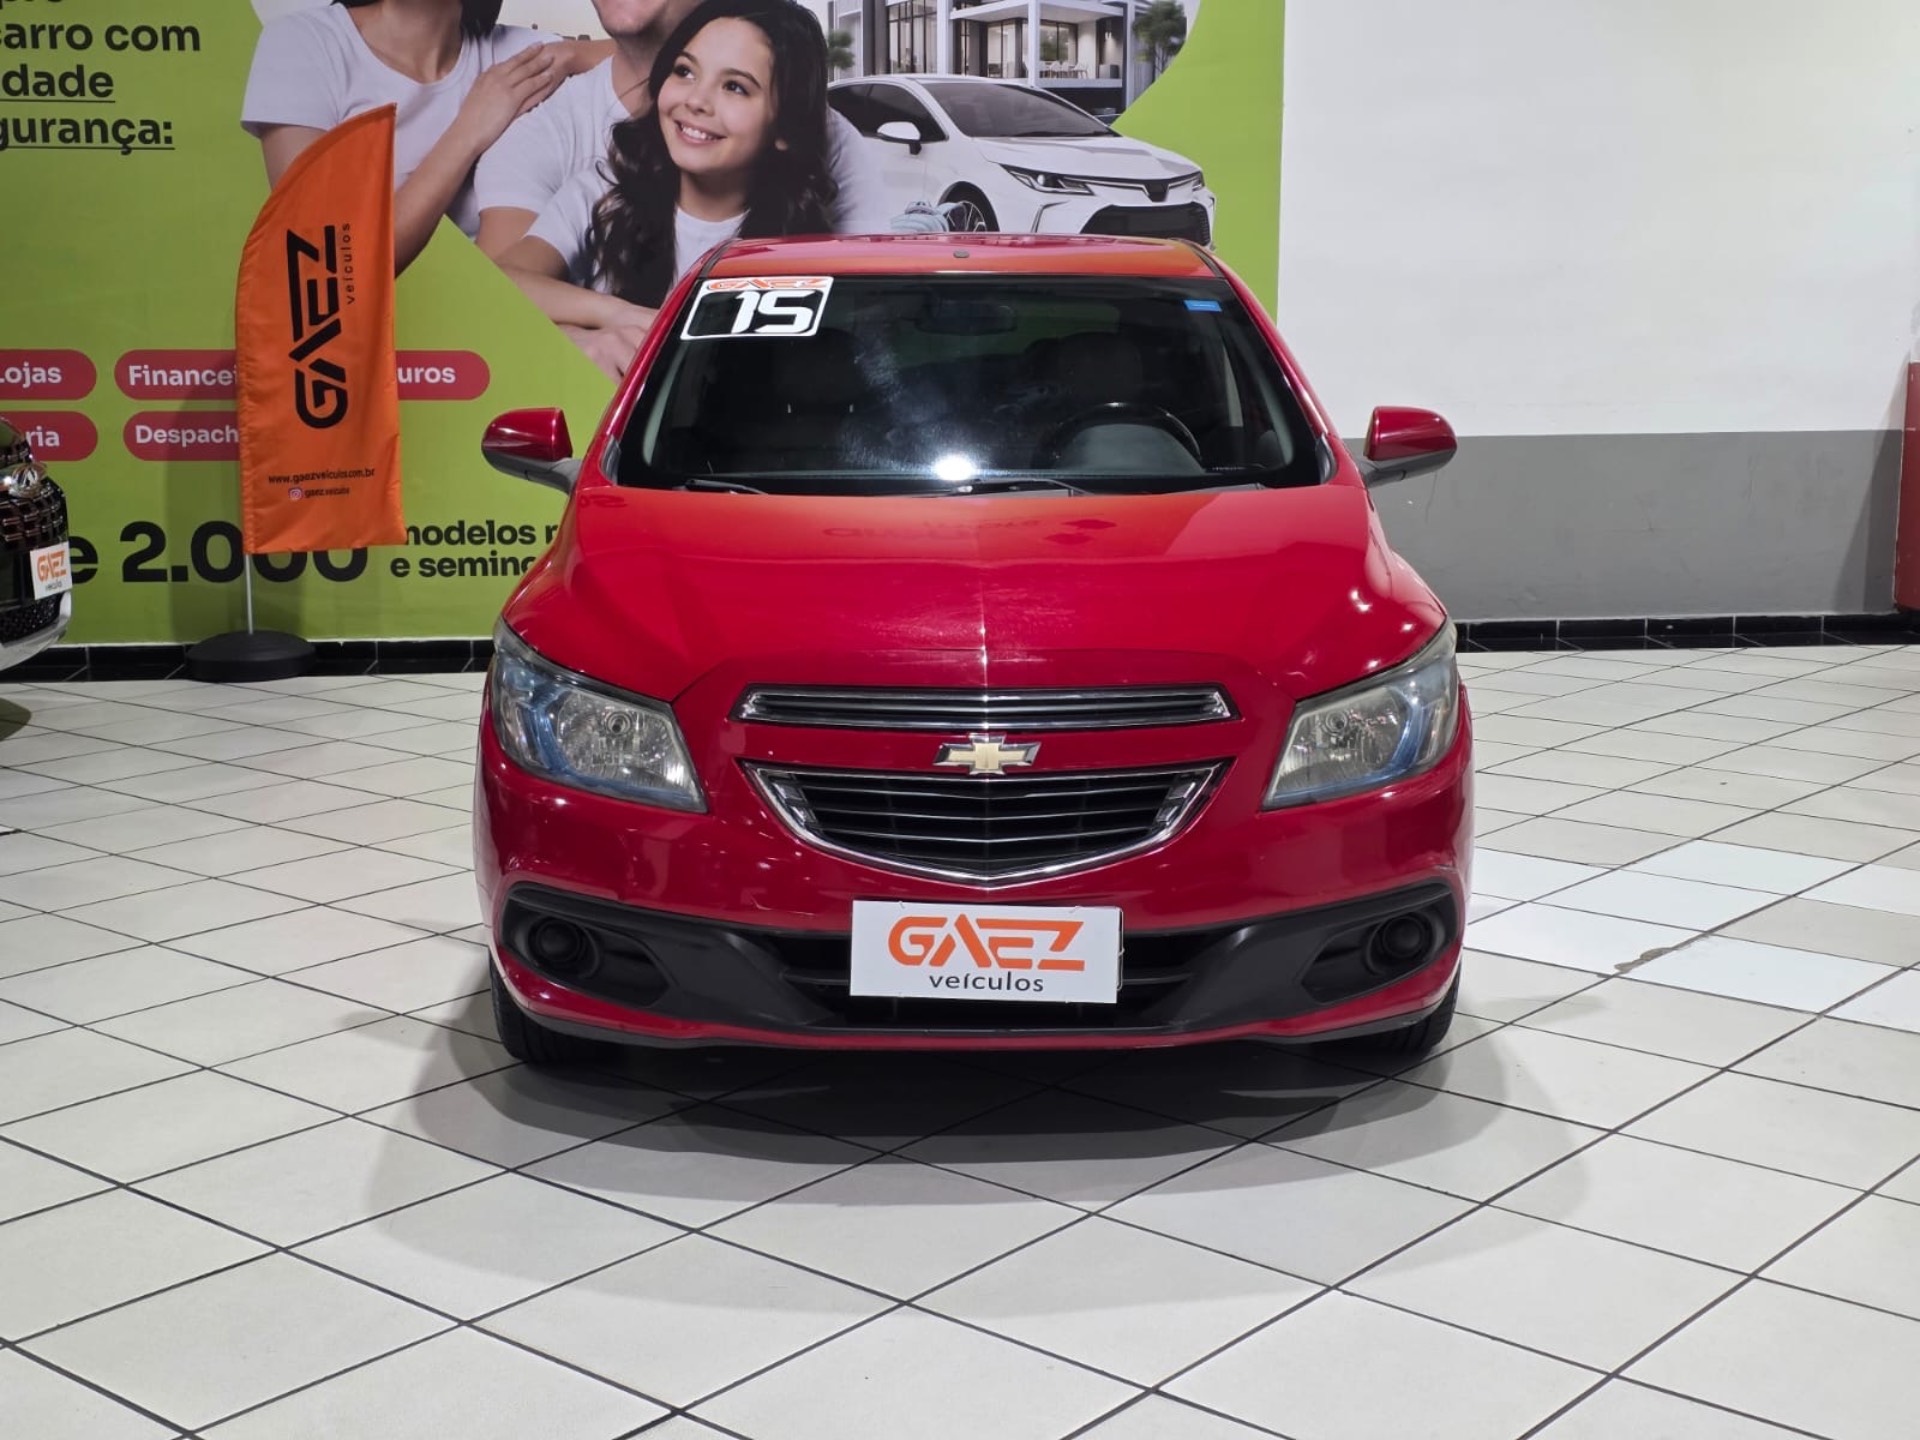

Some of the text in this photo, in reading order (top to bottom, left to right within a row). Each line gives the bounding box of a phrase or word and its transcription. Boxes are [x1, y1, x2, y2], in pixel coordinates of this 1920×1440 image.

[0, 23, 201, 51] arro com
[2, 63, 114, 98] dade
[286, 225, 349, 429] GAEZ
[730, 289, 816, 335] 15
[390, 557, 410, 578] e
[888, 913, 1085, 972] GAEZ
[929, 971, 1044, 992] veículos
